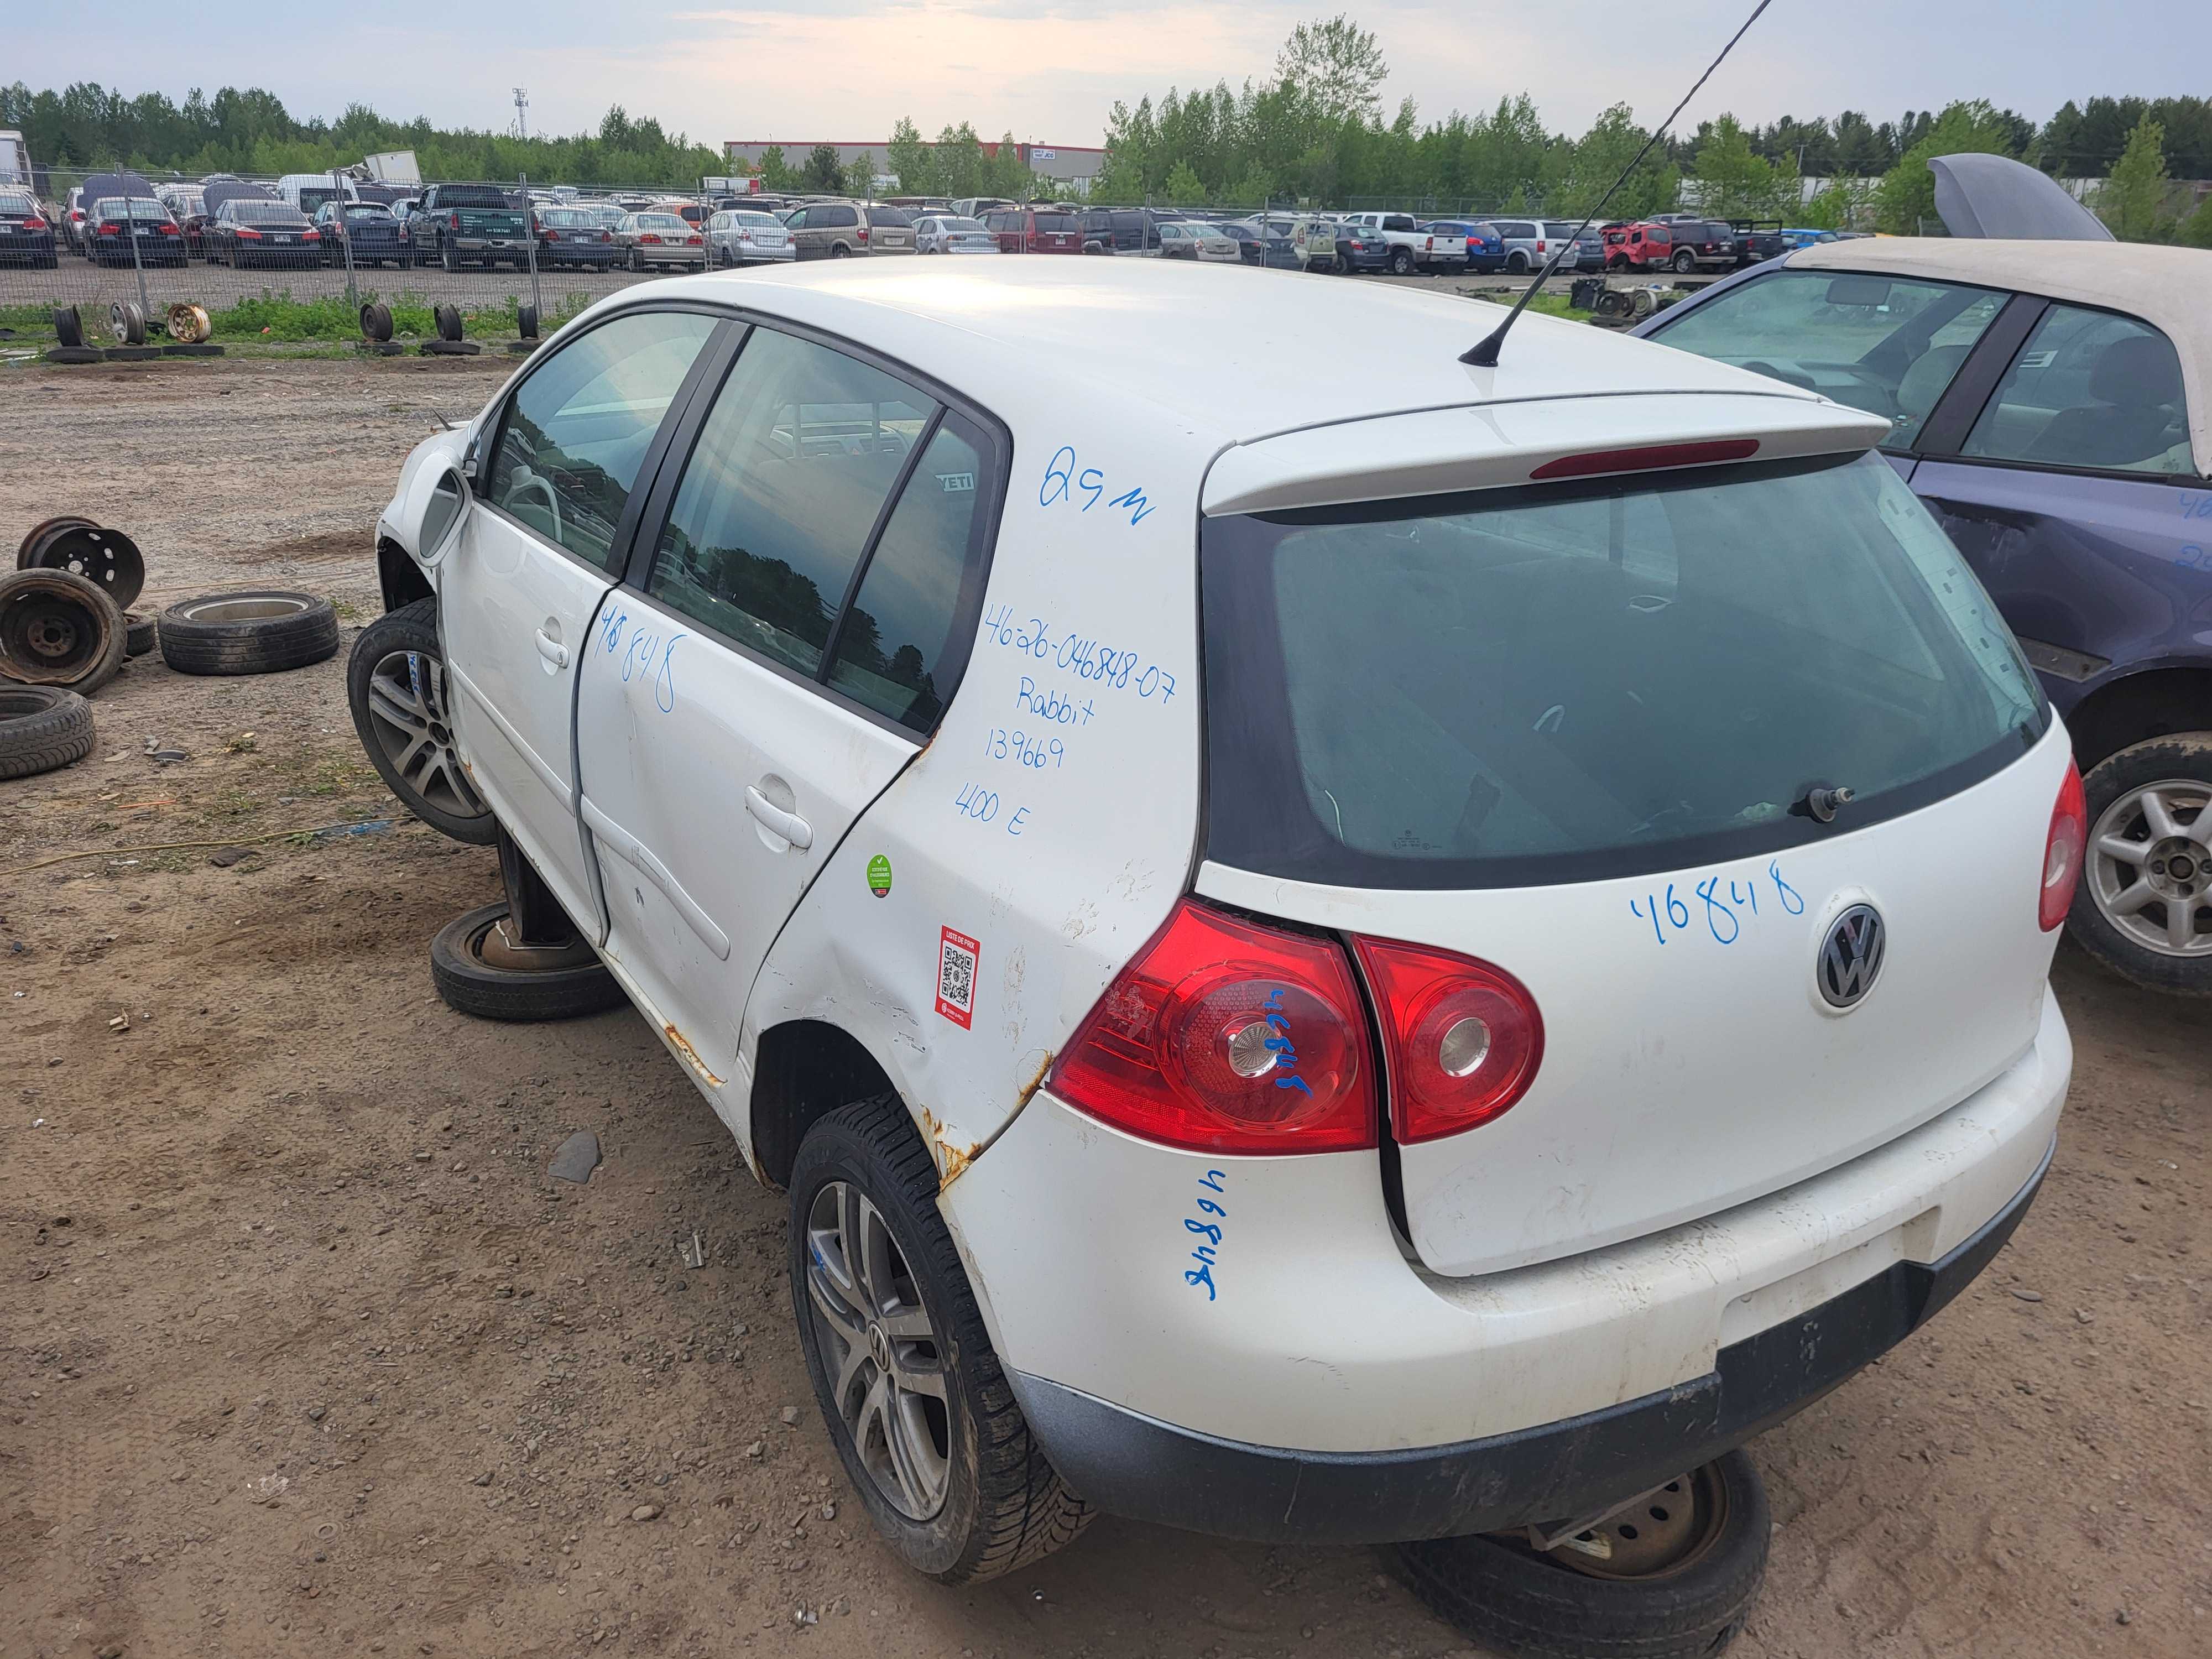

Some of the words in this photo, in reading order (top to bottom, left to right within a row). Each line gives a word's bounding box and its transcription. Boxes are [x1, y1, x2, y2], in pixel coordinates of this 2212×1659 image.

[1016, 676, 1094, 726] Rabbit
[985, 729, 1063, 768] 139669
[955, 782, 999, 822] 400
[1008, 807, 1031, 835] E
[1630, 859, 1804, 945] 46848
[946, 930, 958, 942] LISTE
[958, 936, 964, 945] DE
[964, 938, 975, 950] PRIX
[1184, 1170, 1227, 1301] 46848
